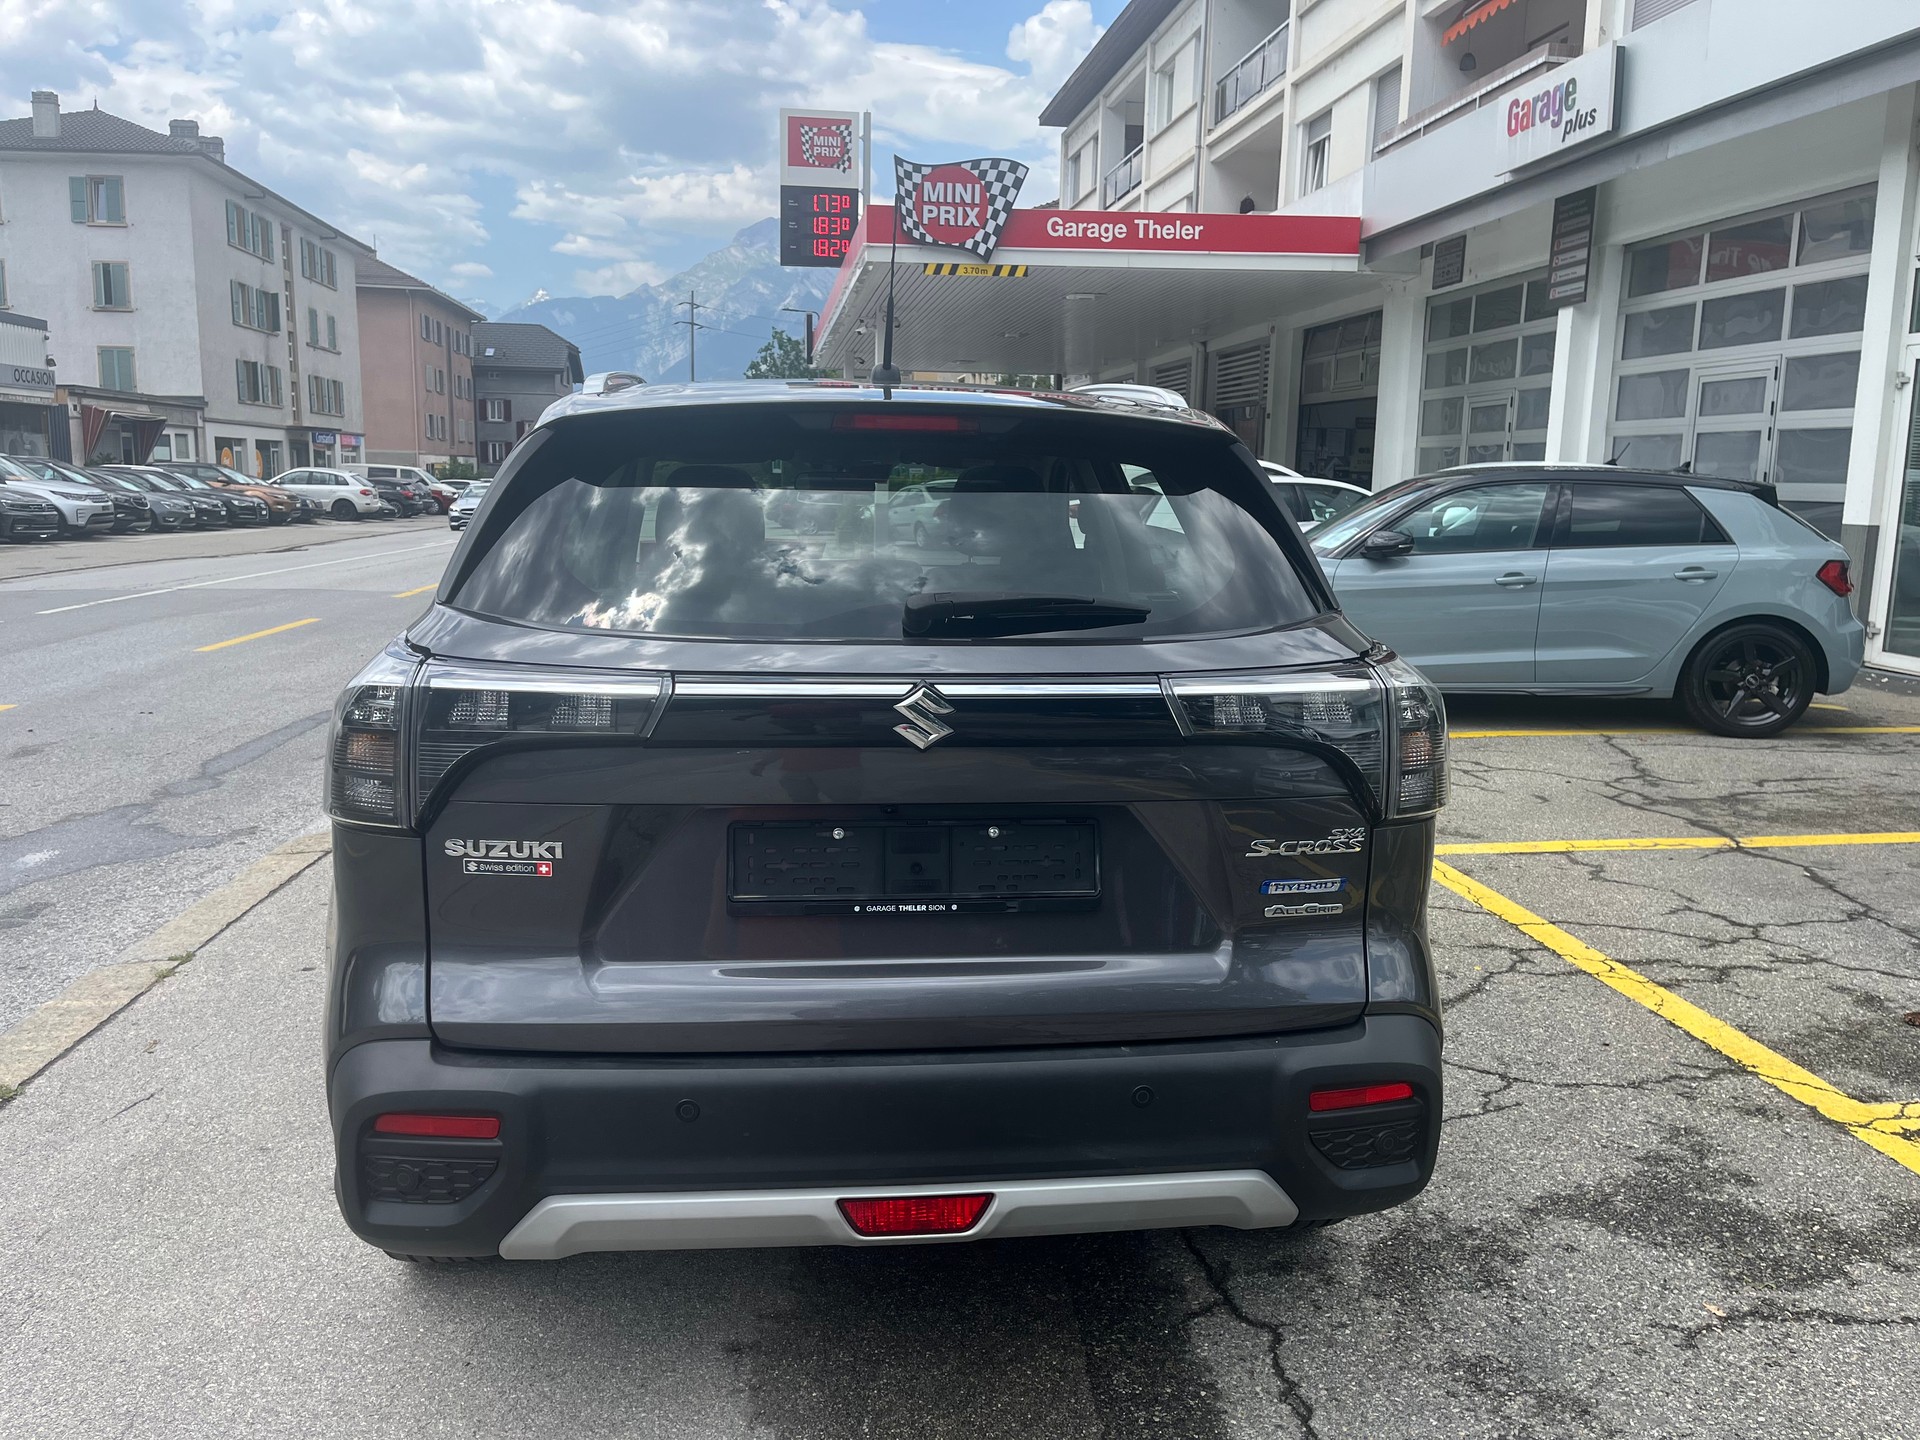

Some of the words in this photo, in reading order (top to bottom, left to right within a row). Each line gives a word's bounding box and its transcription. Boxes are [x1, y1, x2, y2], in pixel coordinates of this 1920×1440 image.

[1507, 77, 1577, 138] Garage
[1561, 108, 1597, 143] plus
[813, 135, 841, 146] MINI
[813, 146, 841, 157] PRIX
[923, 181, 981, 204] MINI
[922, 204, 980, 227] PRIX
[1046, 216, 1127, 243] Garage
[1134, 219, 1204, 240] Theler
[13, 368, 55, 386] OCCASION
[1327, 827, 1366, 840] SX4
[444, 838, 563, 859] SUZUKI
[479, 863, 504, 872] swiss
[505, 863, 535, 872] edition
[1274, 881, 1338, 892] HYBRID
[866, 904, 896, 912] GARAGE
[898, 904, 927, 912] THELER
